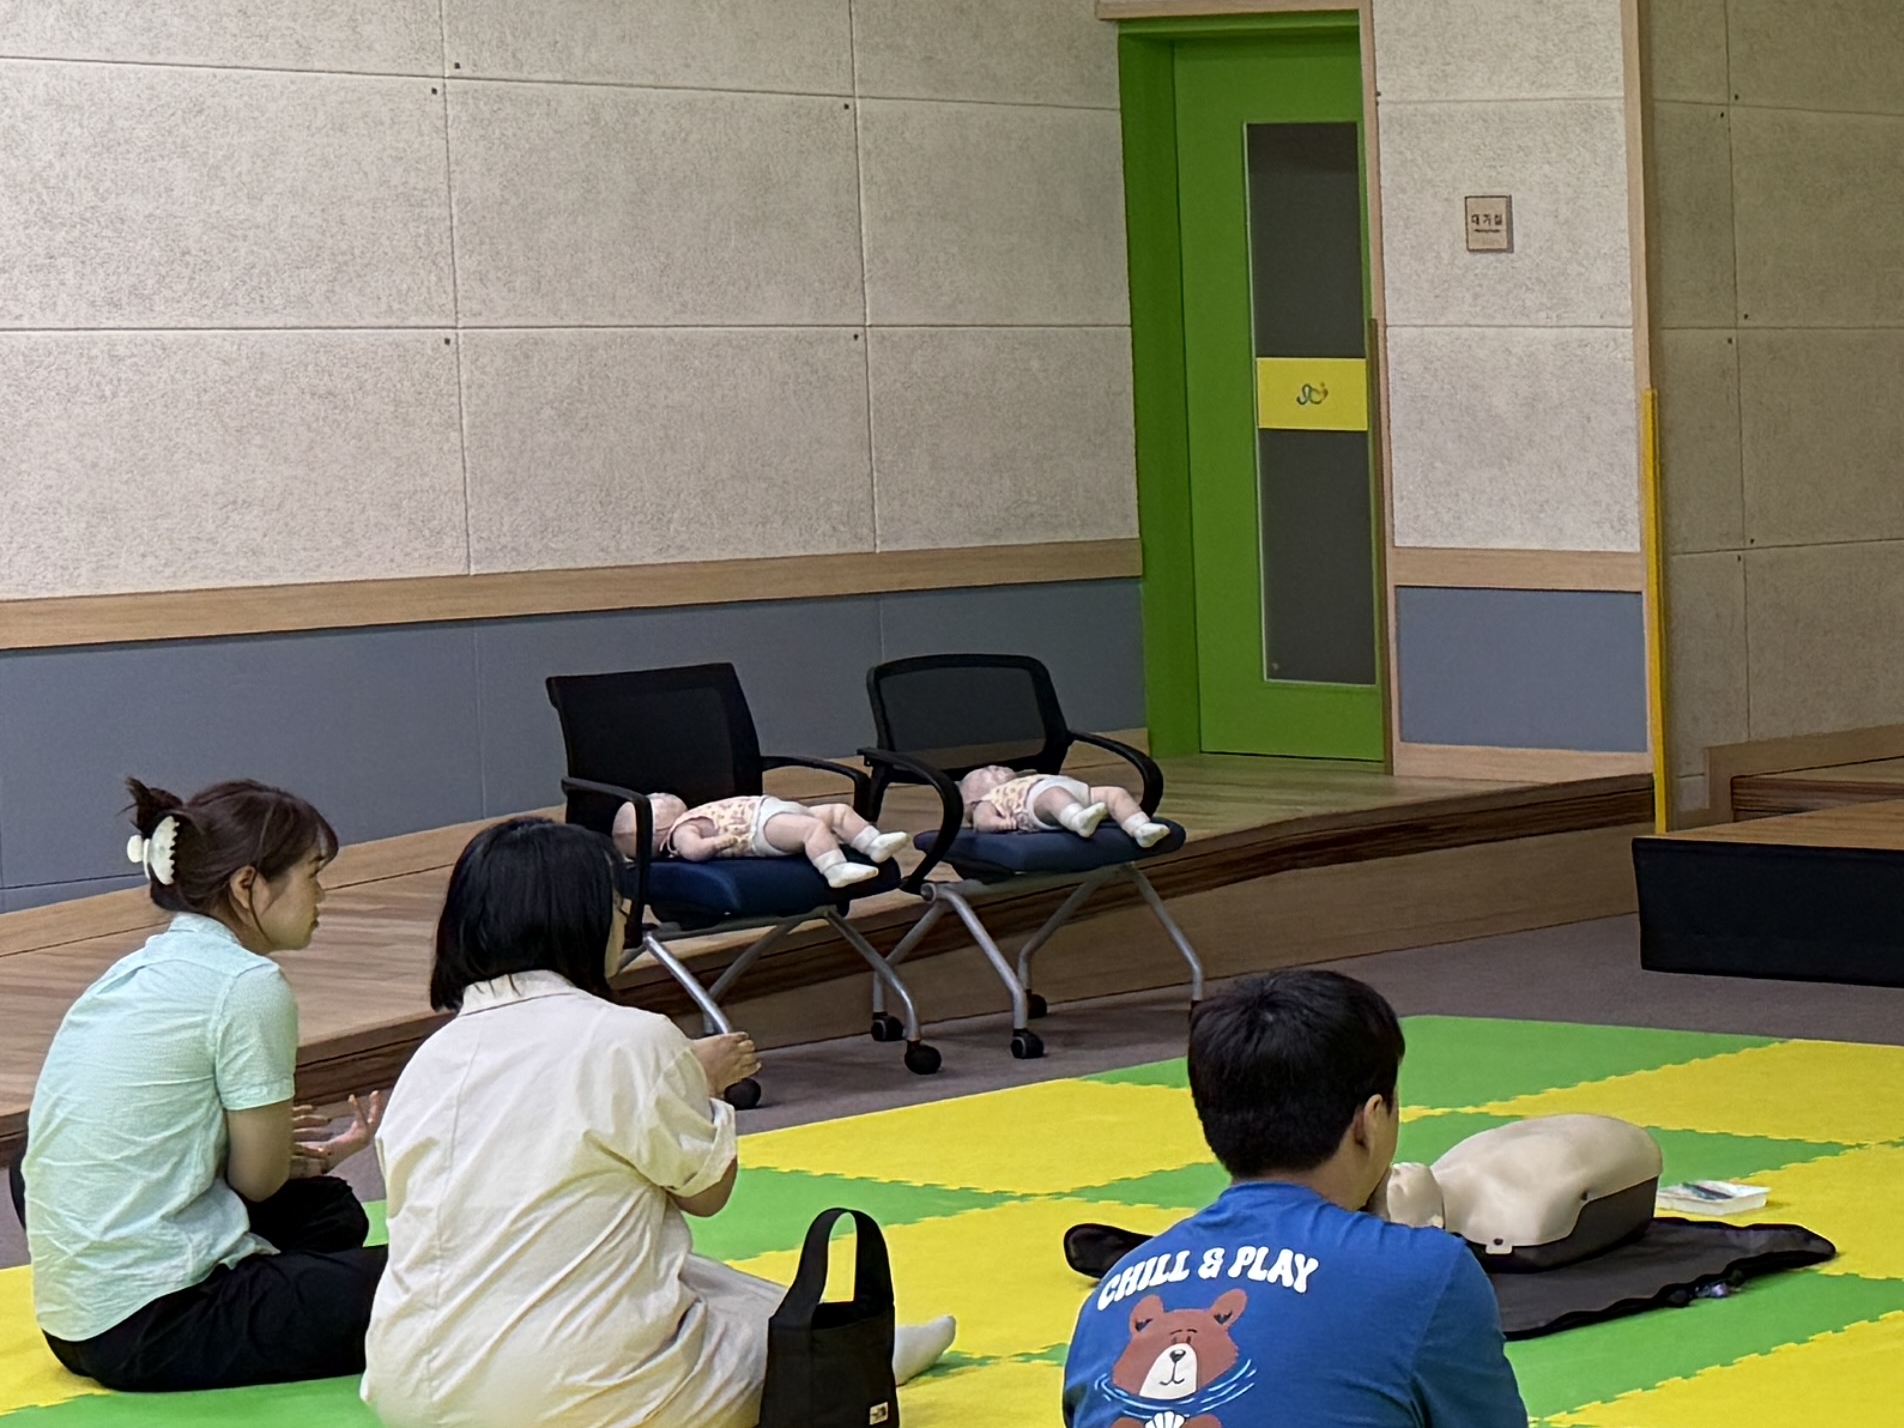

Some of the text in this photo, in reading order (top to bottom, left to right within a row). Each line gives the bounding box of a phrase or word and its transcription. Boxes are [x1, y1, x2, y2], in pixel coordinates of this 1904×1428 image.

[1097, 1246, 1319, 1310] CHILL & PLAY
